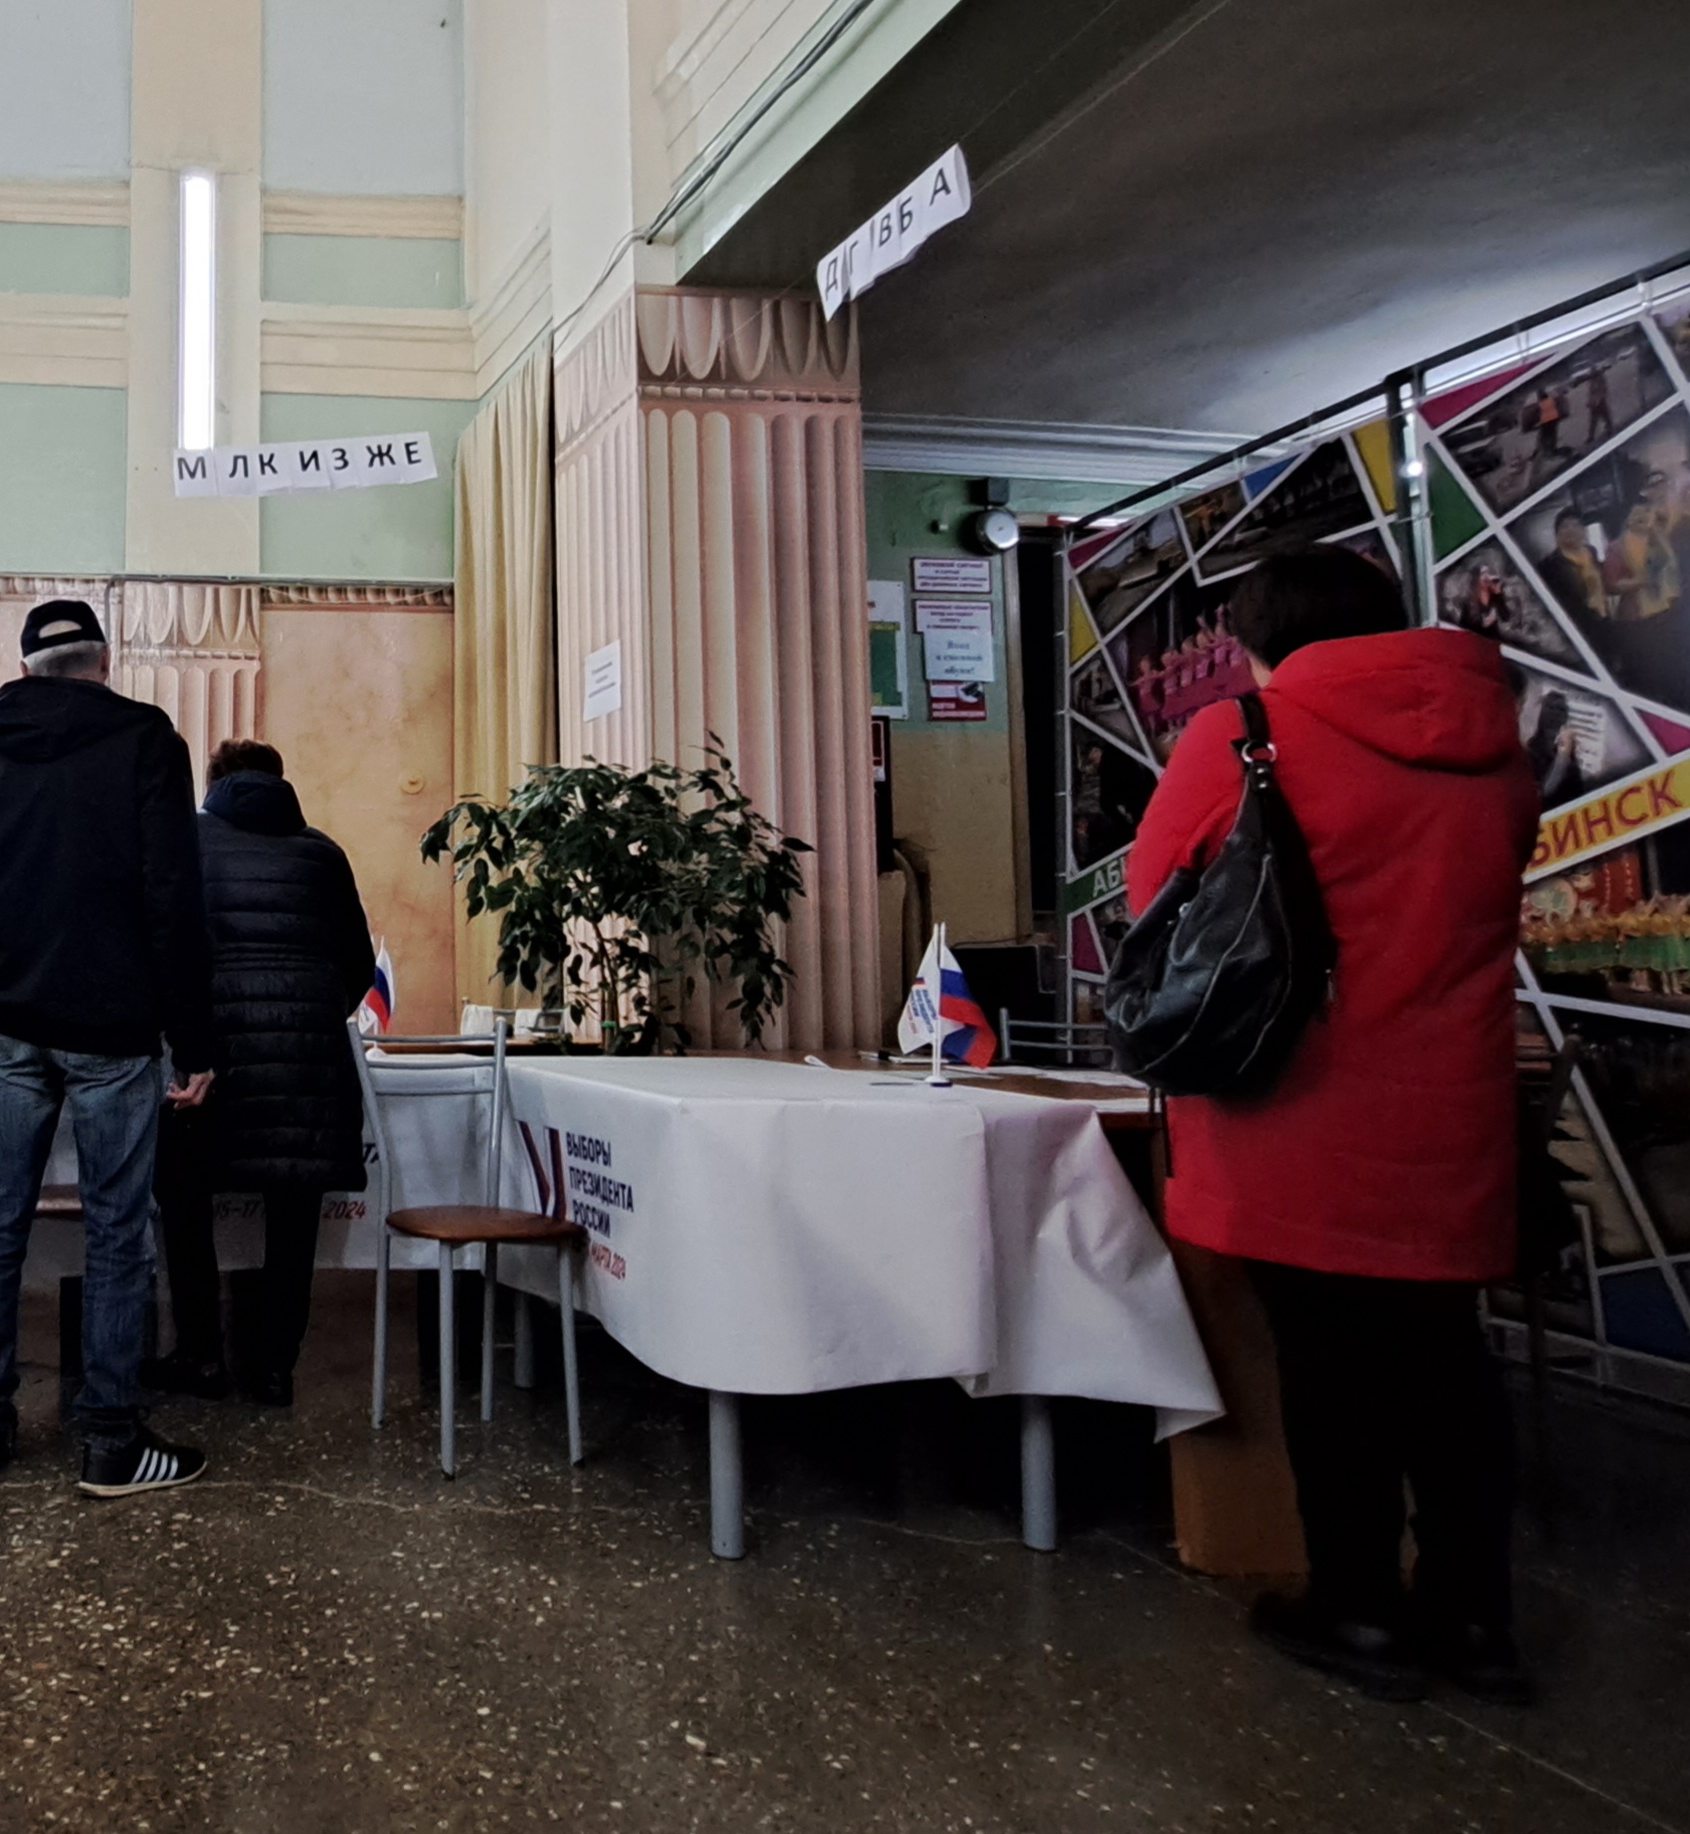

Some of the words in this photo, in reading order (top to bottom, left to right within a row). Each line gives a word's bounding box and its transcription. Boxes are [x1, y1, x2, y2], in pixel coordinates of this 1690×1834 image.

[566, 1132, 611, 1167] ВЫБОРЫ
[569, 1166, 634, 1212] ПРЕЗИДЕНТА
[323, 1201, 367, 1220] 2024
[573, 1199, 611, 1238] РОССИИ
